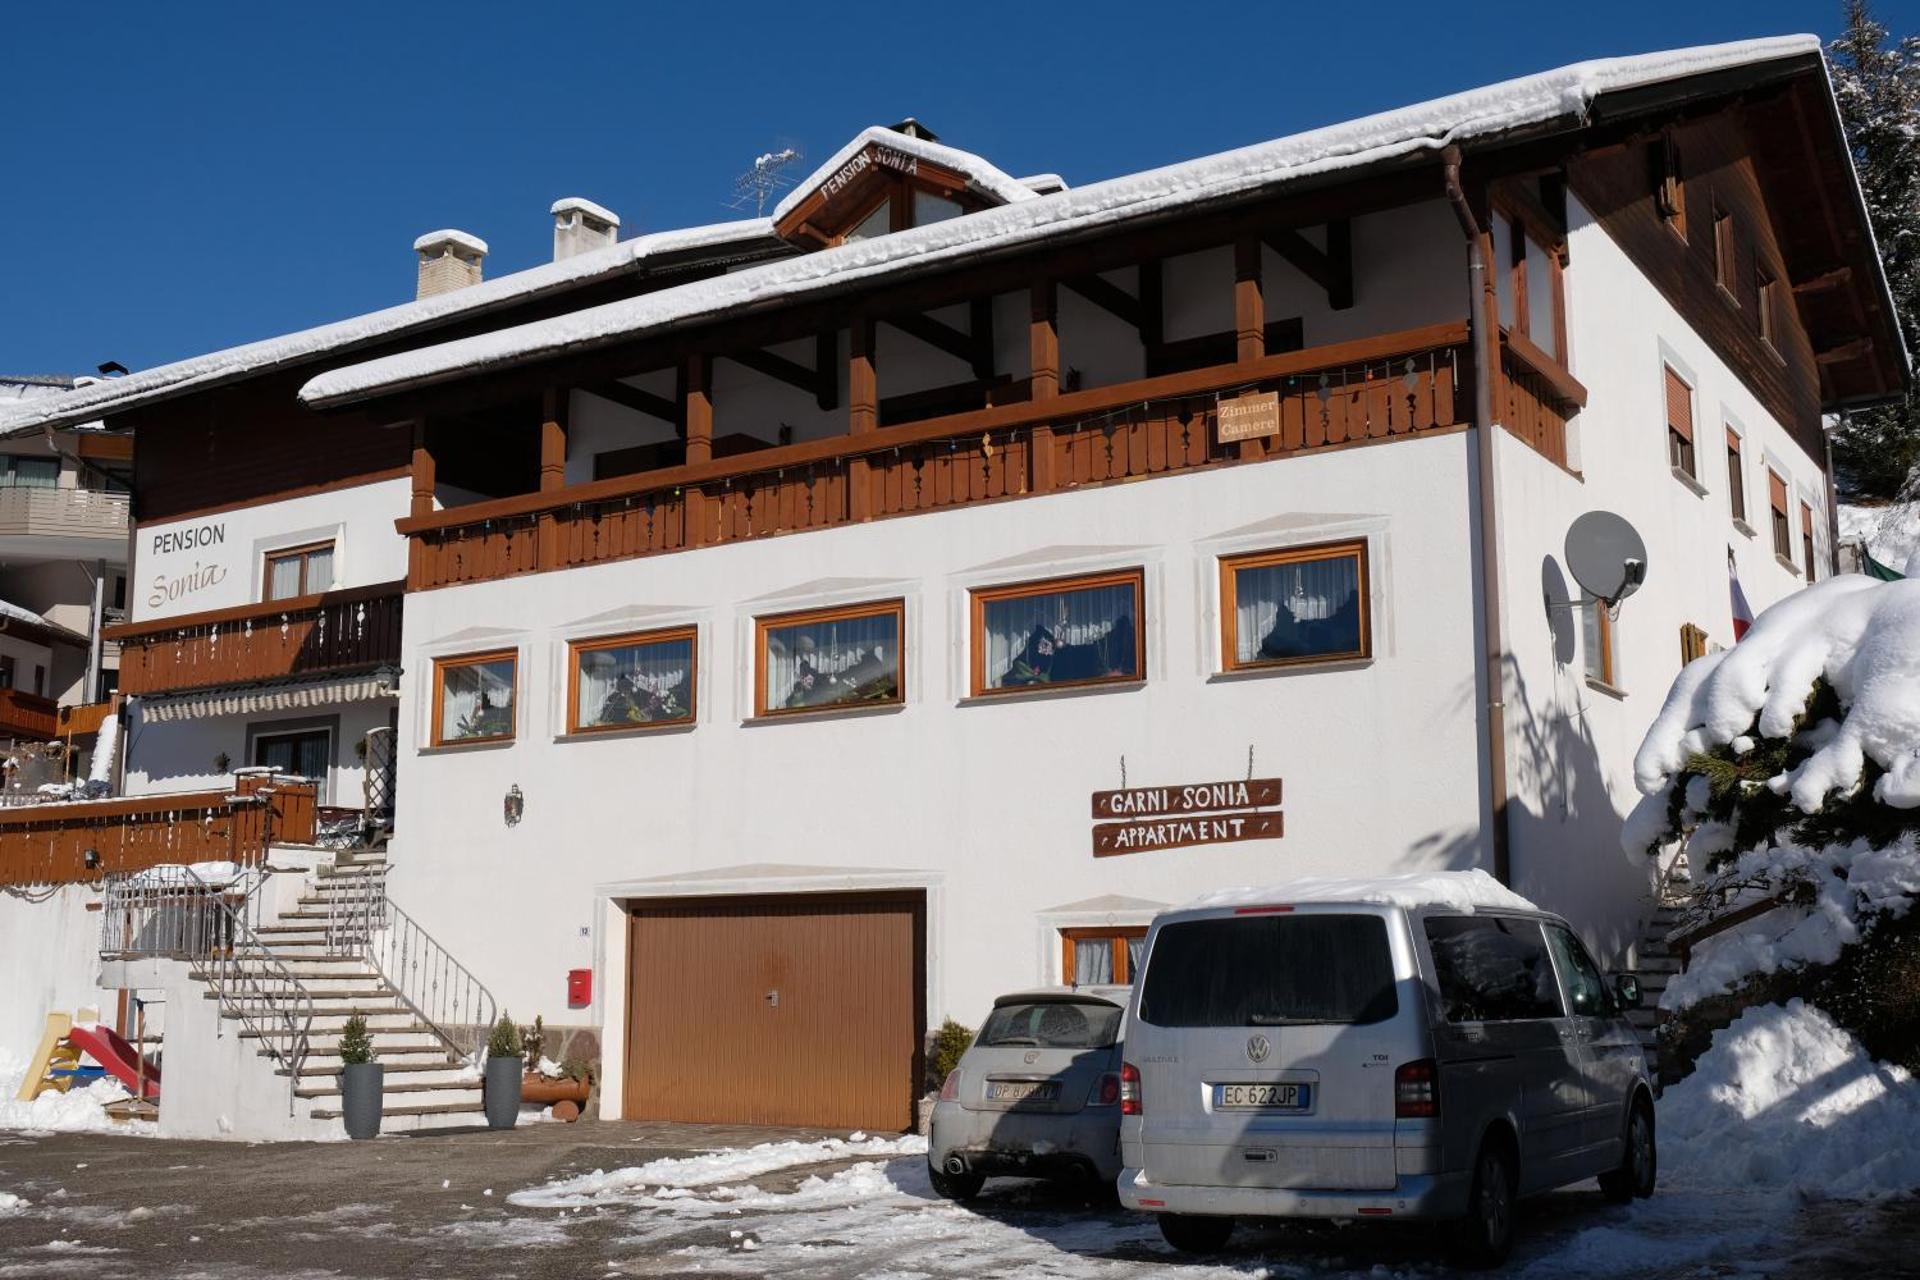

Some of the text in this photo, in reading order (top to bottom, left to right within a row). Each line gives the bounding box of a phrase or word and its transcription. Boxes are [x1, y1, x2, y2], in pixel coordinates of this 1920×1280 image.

[820, 147, 918, 200] PENSION SONIA
[1220, 401, 1275, 418] Zimmer
[1221, 420, 1275, 436] Camere
[153, 523, 225, 555] PENSION
[148, 561, 227, 608] Sonia
[1111, 783, 1249, 813] GARNI SONIA
[1114, 819, 1246, 848] APPARTMENT
